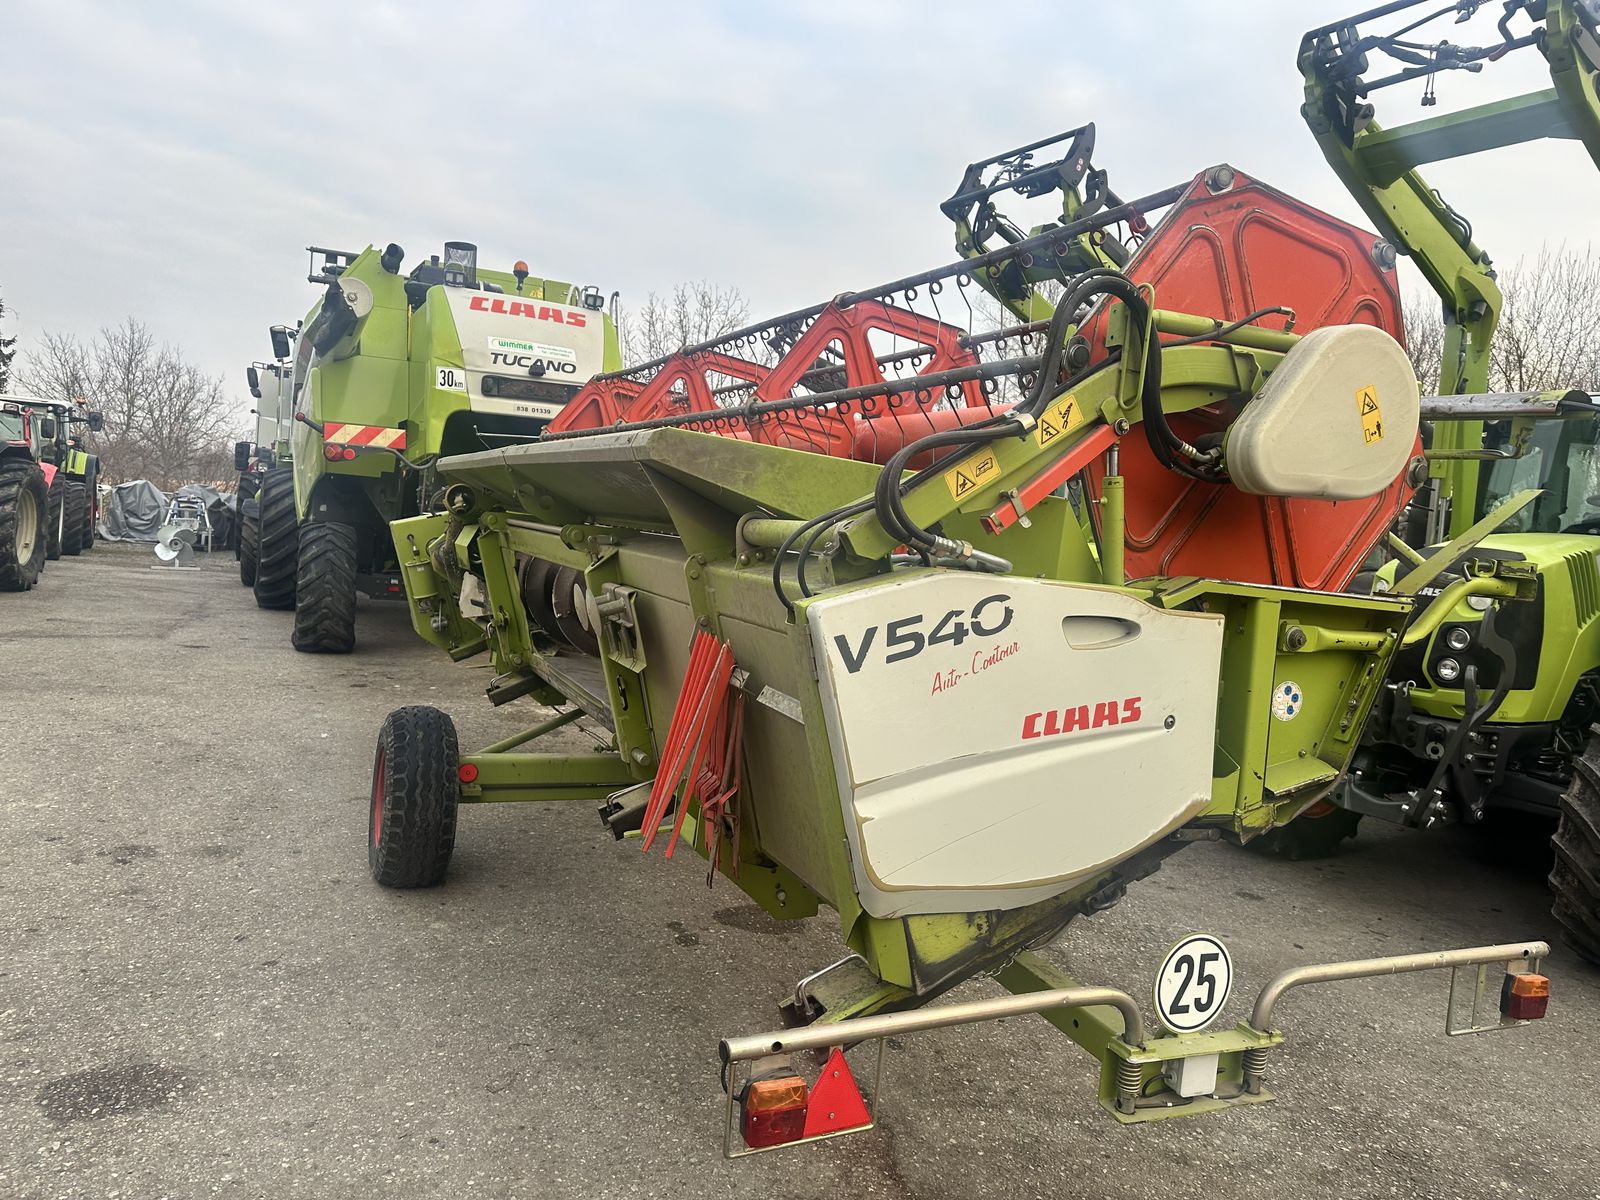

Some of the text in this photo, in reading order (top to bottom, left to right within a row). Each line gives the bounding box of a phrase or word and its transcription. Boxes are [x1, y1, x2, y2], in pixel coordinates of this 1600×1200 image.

[469, 296, 587, 328] CLAAS
[498, 340, 534, 352] WIMMER
[490, 352, 577, 374] TUCANO
[1021, 696, 1142, 740] CLAAS
[1168, 952, 1220, 1016] 25
